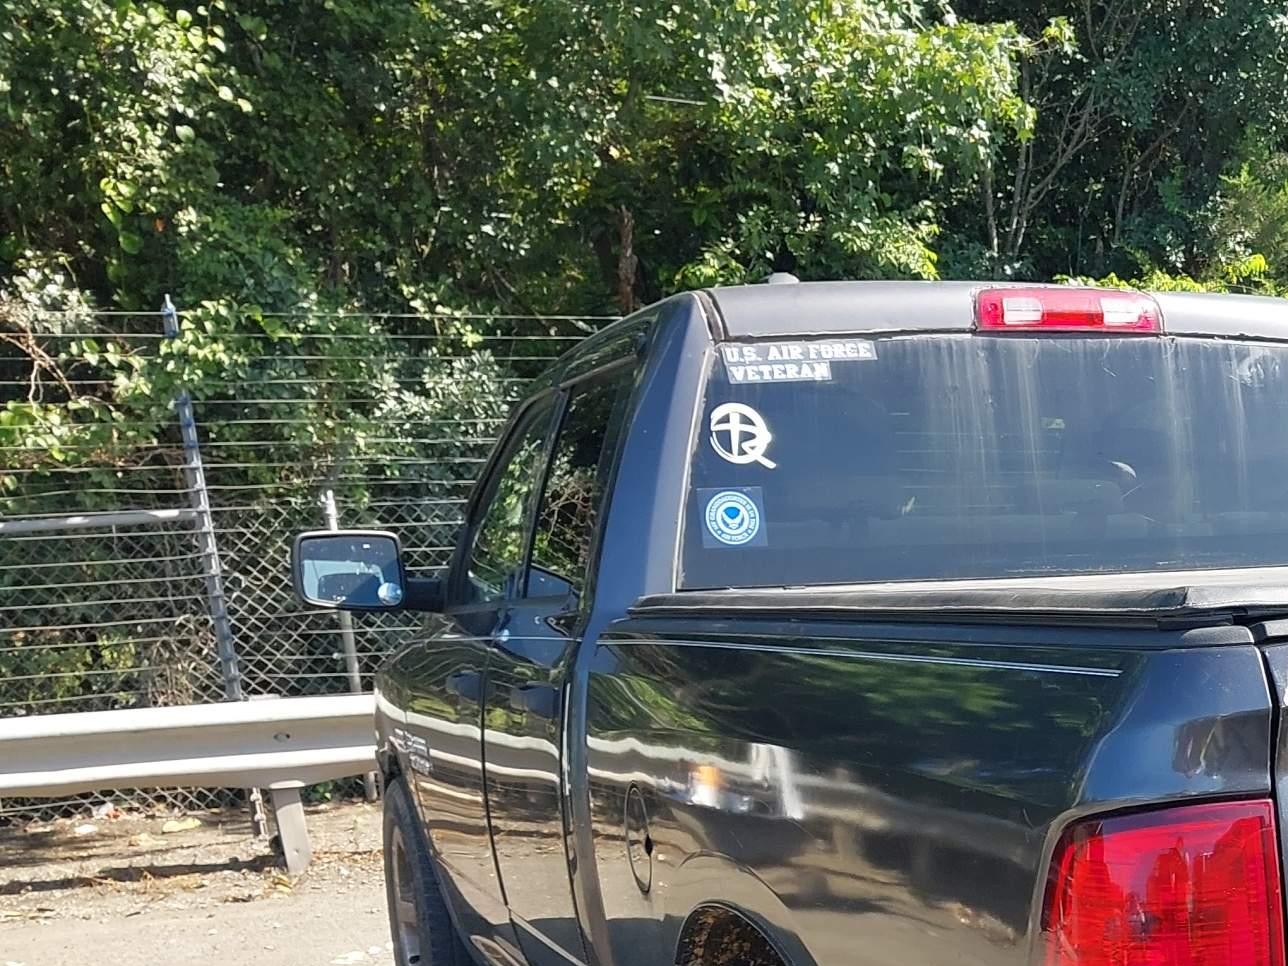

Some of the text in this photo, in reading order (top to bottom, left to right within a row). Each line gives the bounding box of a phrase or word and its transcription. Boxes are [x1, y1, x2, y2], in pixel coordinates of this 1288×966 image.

[727, 342, 872, 362] U.S. AIR FORCE
[728, 361, 829, 381] VETERAN
